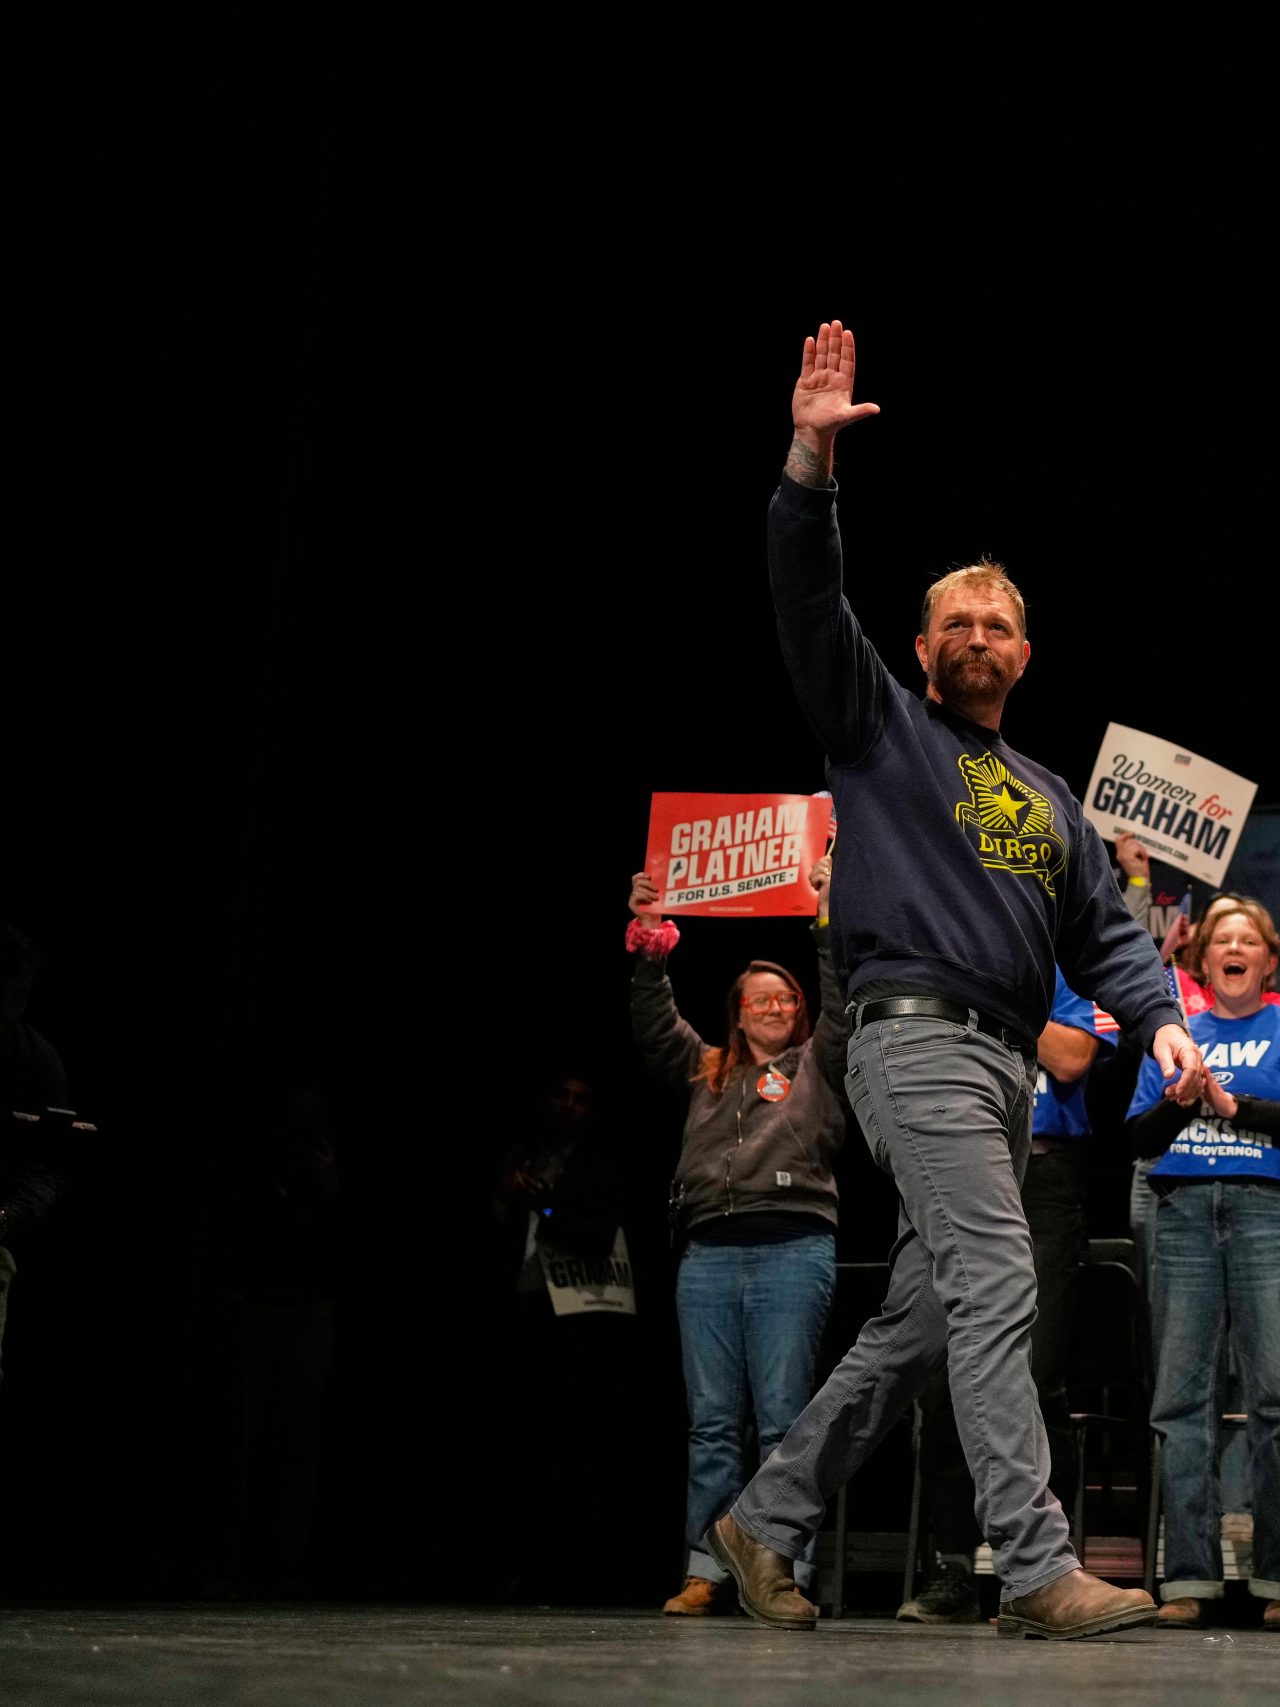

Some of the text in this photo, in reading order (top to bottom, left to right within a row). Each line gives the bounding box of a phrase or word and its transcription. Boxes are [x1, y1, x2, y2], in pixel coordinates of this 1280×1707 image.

[1112, 754, 1232, 821] Women for
[670, 801, 809, 855] GRAHAM
[1092, 776, 1232, 860] GRAHAM
[666, 834, 801, 890] PLATNER
[978, 832, 1052, 864] DIRGO
[677, 871, 787, 903] FOR U.S. SENATE
[1170, 1144, 1262, 1159] FOR GOVERNOR
